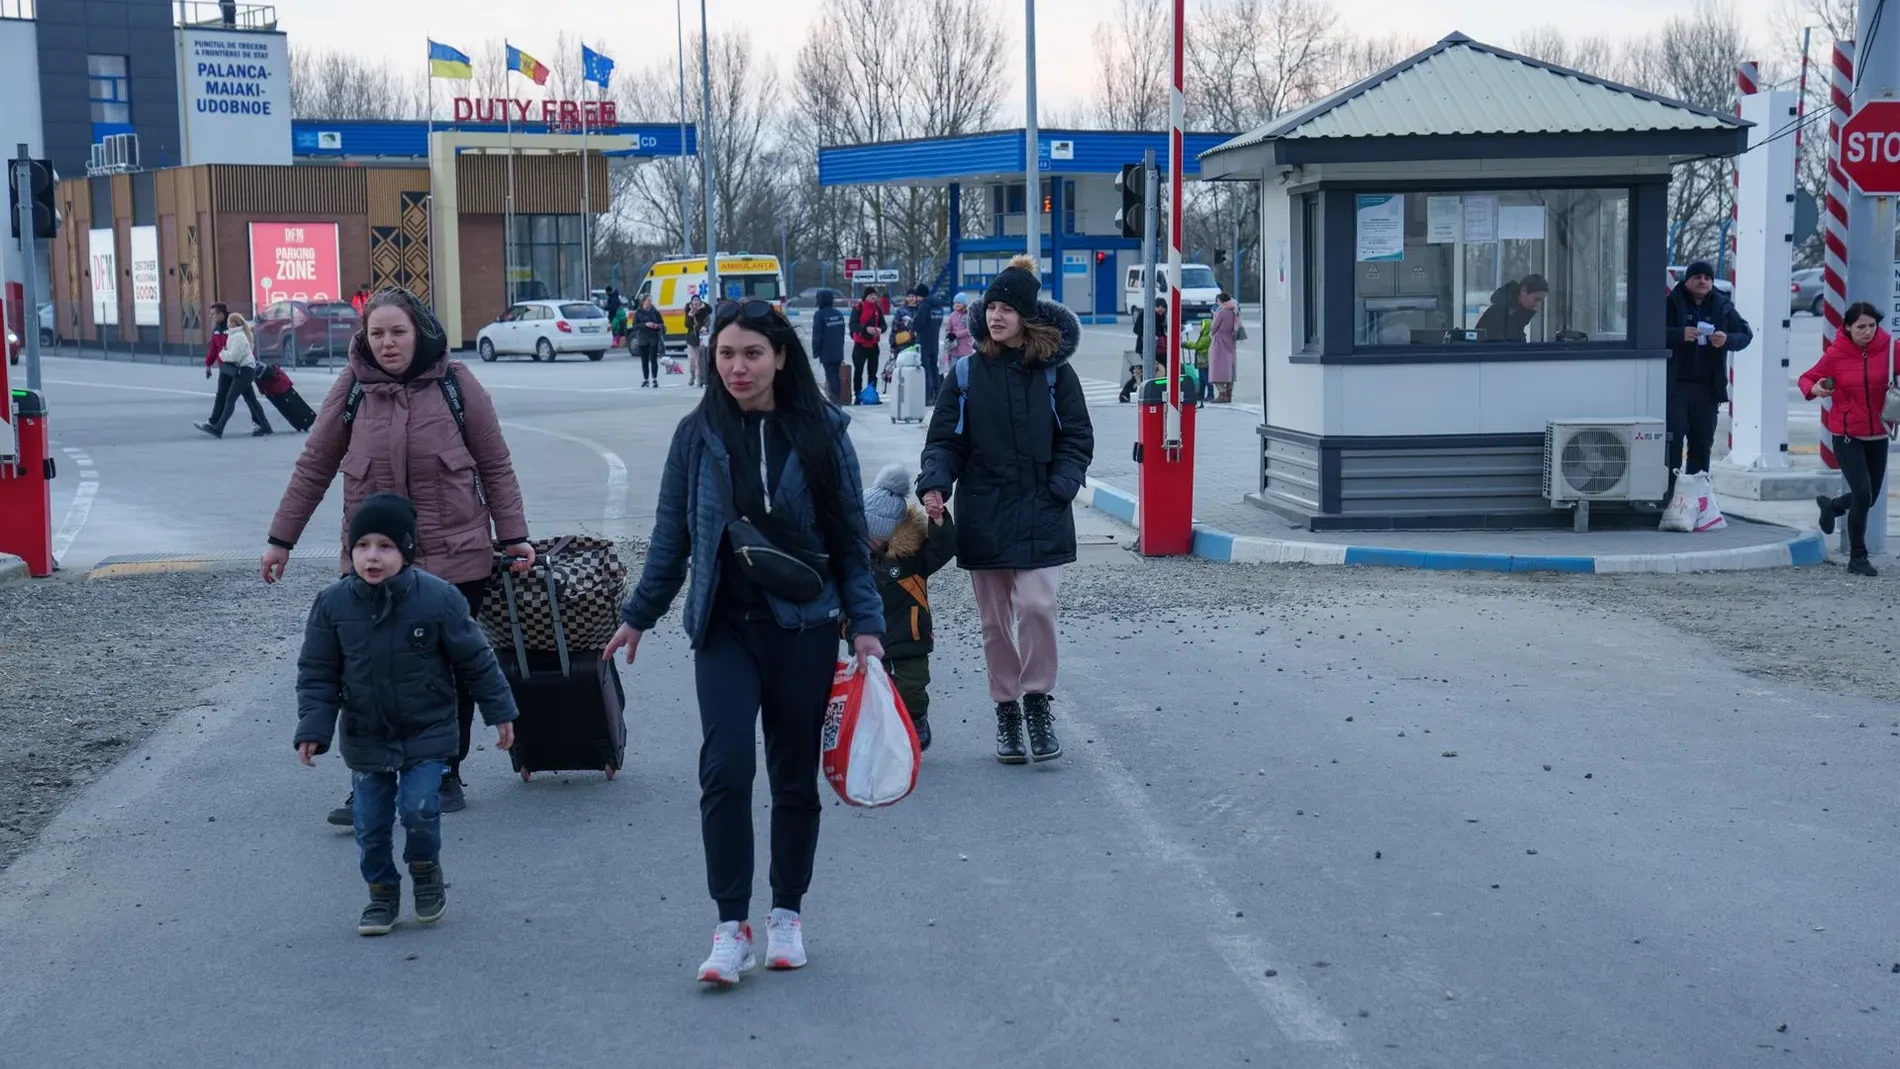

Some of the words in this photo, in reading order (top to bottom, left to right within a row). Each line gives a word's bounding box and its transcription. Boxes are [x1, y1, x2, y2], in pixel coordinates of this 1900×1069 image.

[194, 40, 225, 49] PUNCTUL
[238, 42, 268, 51] TRECERE
[197, 62, 272, 79] PALANCA-
[205, 80, 266, 97] MAIAKI-
[196, 98, 271, 115] UDOBNOE
[453, 97, 532, 123] DUTY
[541, 100, 617, 126] FREE
[1847, 131, 1900, 163] STO
[284, 227, 304, 241] DFM
[275, 247, 315, 260] PARKING
[92, 254, 115, 290] DFM
[276, 260, 317, 280] ZONE
